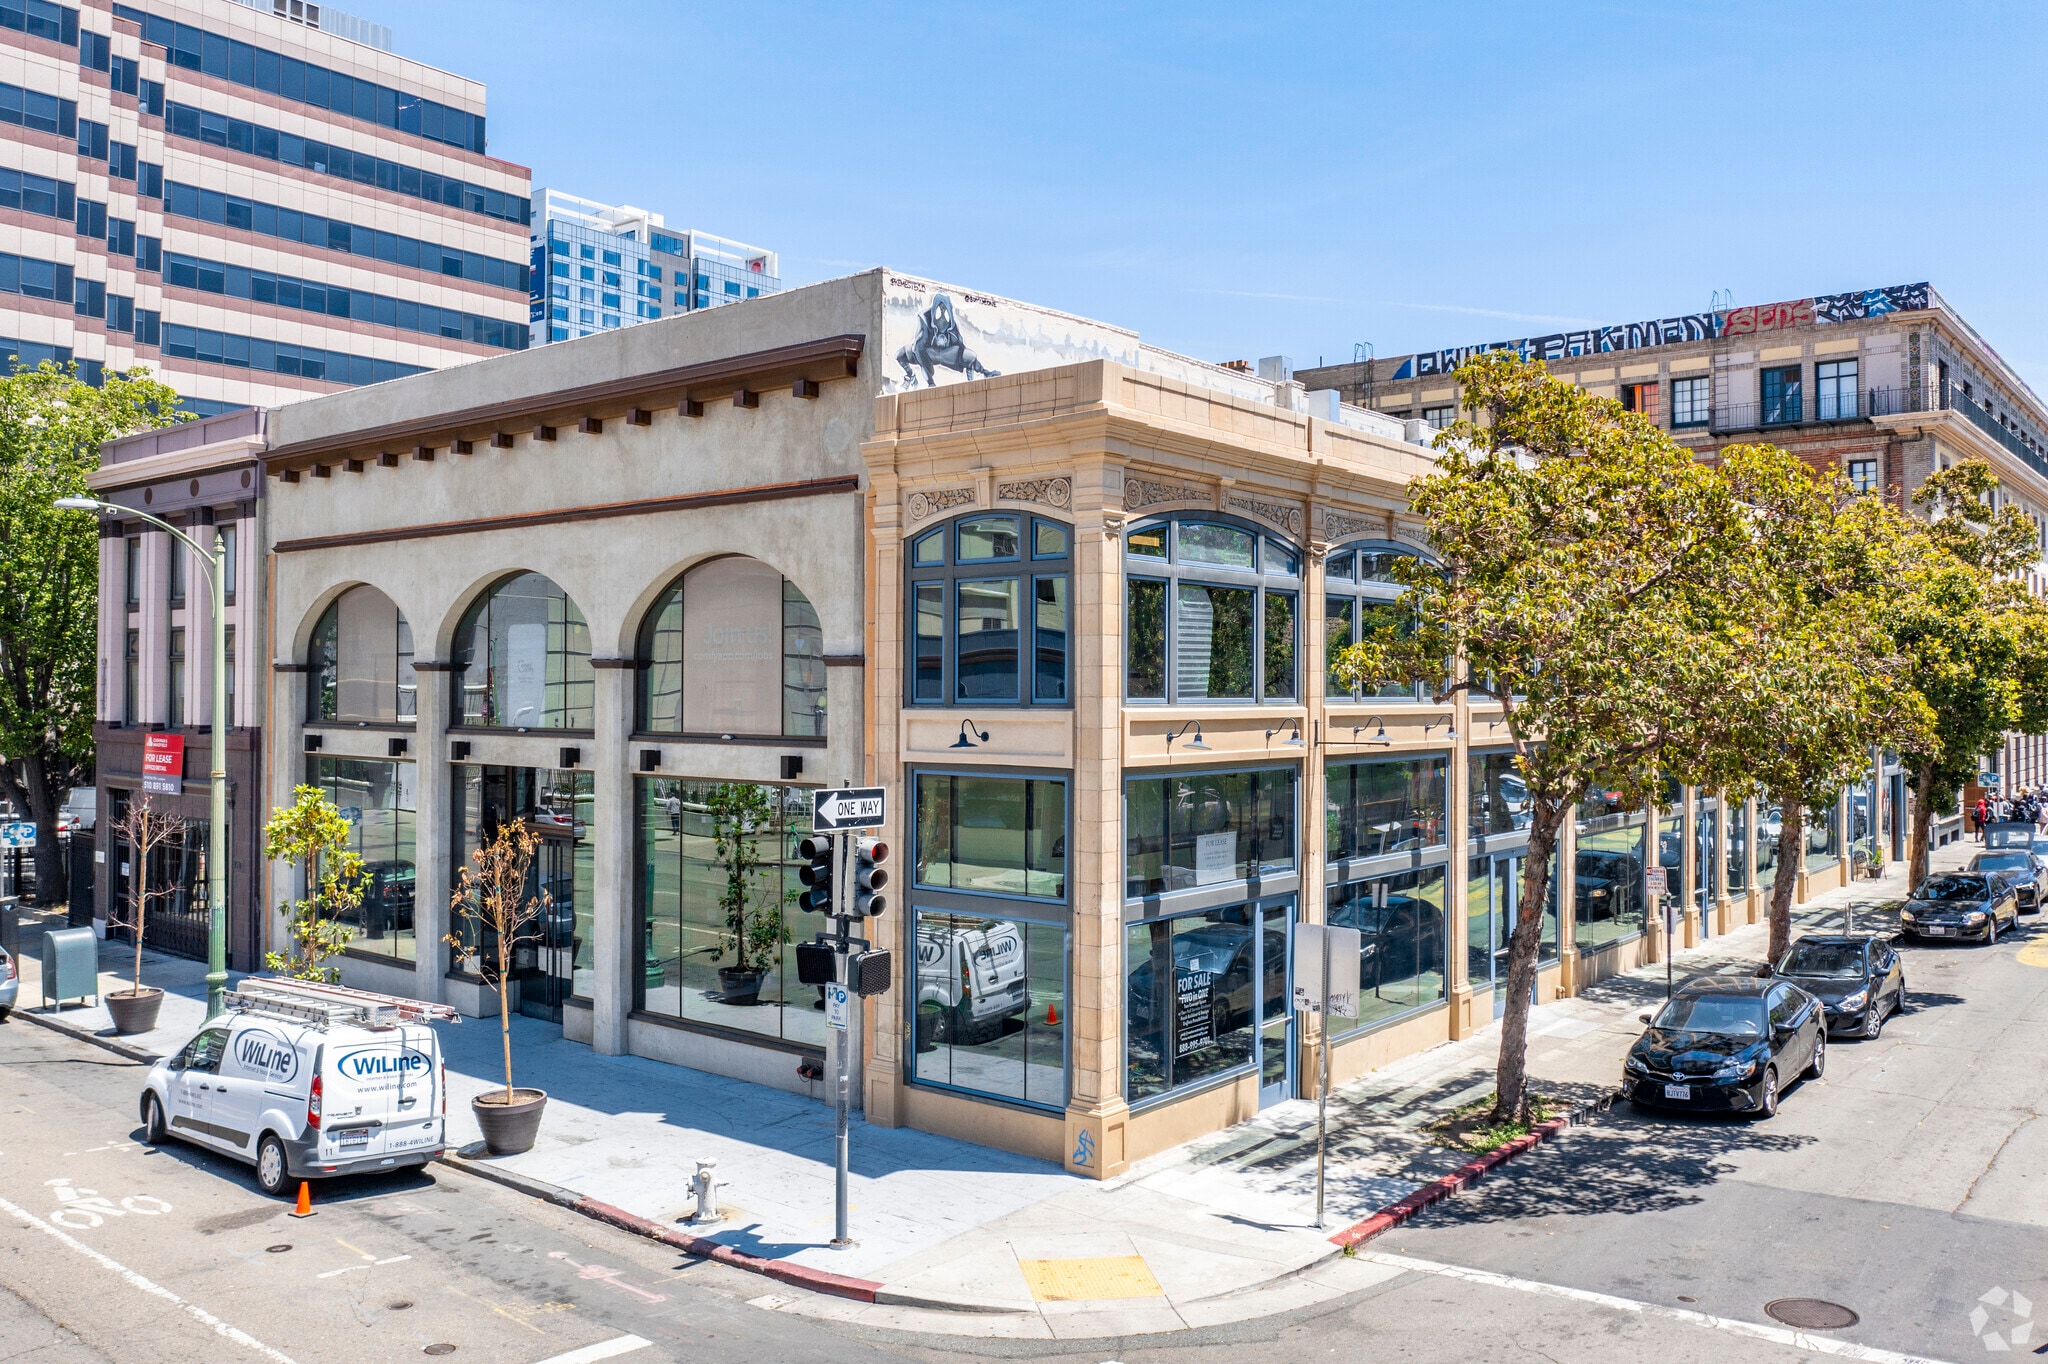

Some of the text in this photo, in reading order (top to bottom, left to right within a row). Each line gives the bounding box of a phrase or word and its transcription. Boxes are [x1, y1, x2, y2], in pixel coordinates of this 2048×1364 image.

[145, 753, 172, 764] FOR LEASE
[837, 798, 880, 816] ONE WAY
[1177, 972, 1211, 993] FOR SALE
[357, 1081, 417, 1093] www.wiline.com
